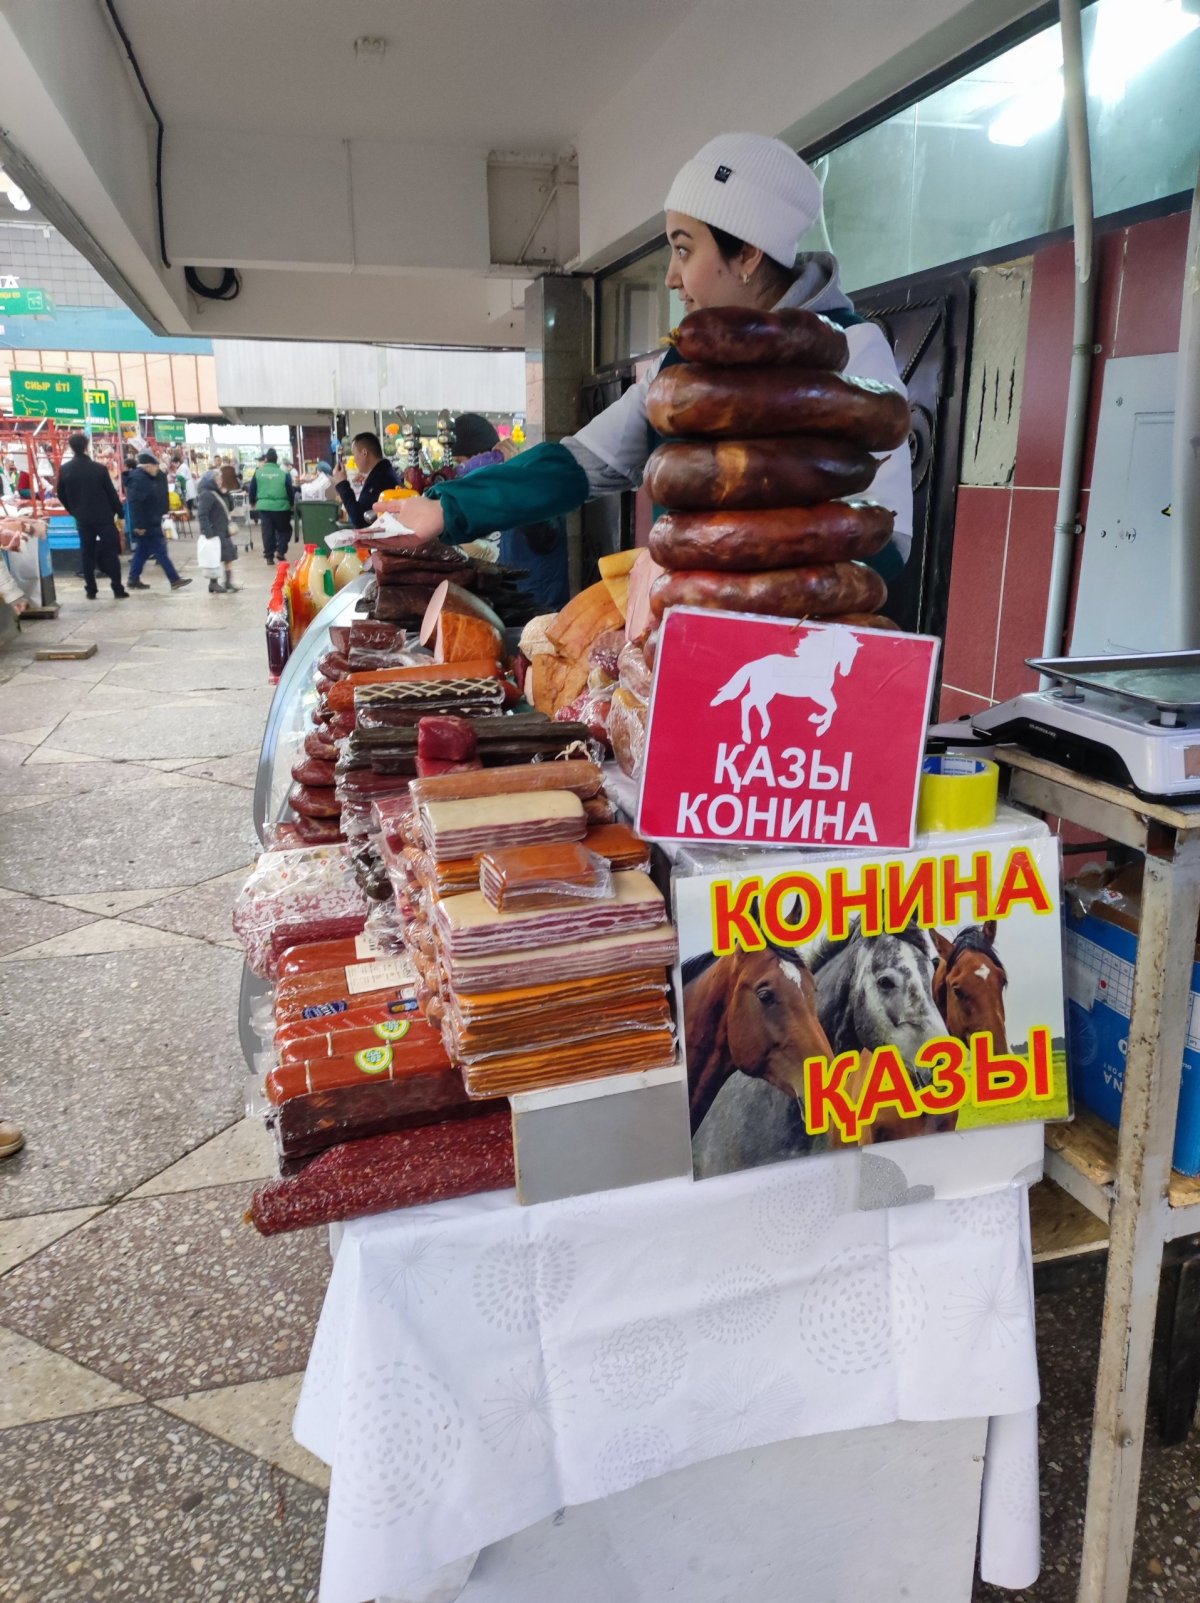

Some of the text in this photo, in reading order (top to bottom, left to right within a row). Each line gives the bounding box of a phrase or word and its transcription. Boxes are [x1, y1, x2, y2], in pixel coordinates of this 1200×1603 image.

[714, 743, 853, 793] ҚАЗЫ
[676, 793, 878, 842] КОНИНА
[710, 846, 1051, 957] КОНИНА
[802, 1024, 1054, 1143] ҚАЗЫ
